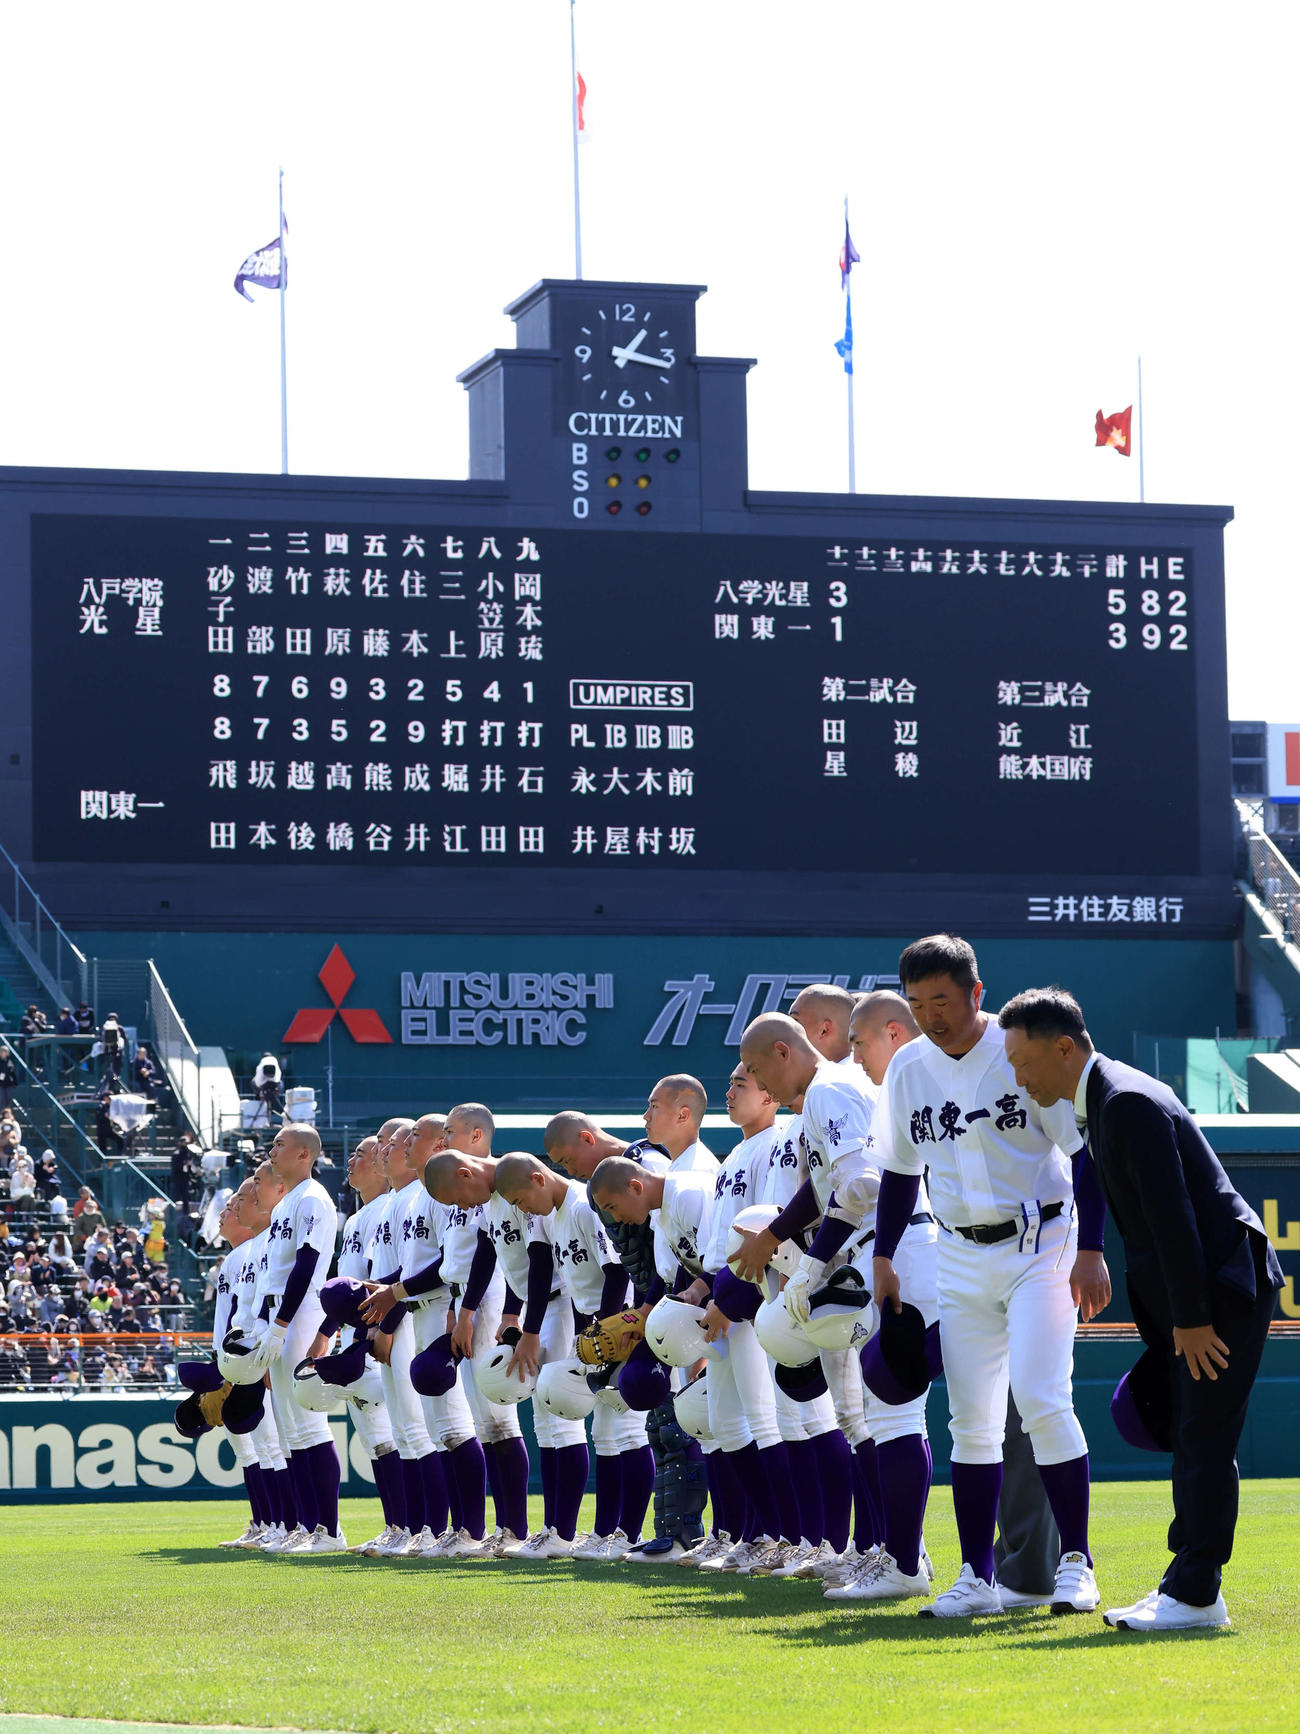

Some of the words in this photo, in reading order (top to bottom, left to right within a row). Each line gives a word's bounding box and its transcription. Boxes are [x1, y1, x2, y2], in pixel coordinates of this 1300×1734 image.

[615, 303, 636, 322] 12
[574, 344, 592, 364] 9
[660, 348, 676, 367] 3
[617, 389, 636, 409] 6
[568, 411, 684, 439] CITIZEN
[571, 442, 588, 466] B
[572, 469, 590, 492] S
[572, 496, 589, 519] O
[247, 532, 272, 552] 二
[286, 531, 311, 554] 三
[324, 532, 349, 555] 四
[363, 533, 388, 557] 五
[402, 534, 425, 558] 六
[439, 535, 464, 559] 七
[477, 536, 502, 560] 八
[515, 536, 541, 562] 九
[1105, 553, 1128, 579] 計
[1139, 556, 1159, 580] H
[1167, 556, 1185, 580] E
[78, 577, 164, 609] 八戸学院
[206, 564, 236, 654] 砂子田
[246, 565, 275, 655] 渡部
[285, 566, 312, 656] 竹田
[323, 567, 352, 656] 萩原
[714, 579, 811, 607] 八学光星
[828, 580, 848, 608] 3
[1107, 588, 1127, 616] 5
[1140, 589, 1161, 617] 8
[1167, 590, 1188, 617] 2
[79, 606, 163, 636] 光星
[361, 568, 390, 657] 佐藤
[400, 569, 429, 658] 住本
[439, 570, 467, 658] 三上
[477, 571, 505, 660] 小笠原
[514, 572, 543, 661] 岡本琉
[714, 613, 812, 641] 関東一
[830, 615, 843, 642] 1
[1108, 622, 1128, 650] 3
[1141, 623, 1162, 651] 9
[1168, 623, 1188, 651] 2
[212, 673, 232, 698] 8
[252, 675, 270, 698] 7
[291, 675, 309, 699] 6
[329, 676, 348, 700] 9
[368, 677, 387, 701] 3
[407, 678, 425, 701] 2
[445, 679, 463, 703] 5
[482, 680, 502, 703] 4
[522, 681, 534, 704] 1
[578, 685, 685, 706] UMPIRES
[821, 676, 918, 704] 第二試合
[997, 680, 1092, 708] 第三試合
[213, 716, 232, 740] 8
[253, 717, 270, 740] 7
[291, 717, 310, 741] 3
[330, 719, 349, 742] 5
[369, 719, 387, 743] 2
[407, 720, 426, 744] 9
[441, 718, 468, 747] 打
[479, 719, 506, 747] 打
[517, 720, 544, 748] 打
[570, 723, 596, 748] PL
[822, 718, 918, 746] 田辺
[998, 721, 1093, 749] 近江
[823, 750, 919, 778] 星稜
[998, 753, 1093, 781] 熊本国府
[80, 789, 165, 820] 関東一
[209, 759, 237, 850] 飛田
[247, 760, 277, 850] 坂本
[287, 760, 316, 851] 越後
[364, 762, 393, 852] 熊谷
[403, 763, 431, 852] 成井
[441, 763, 470, 853] 堀江
[480, 764, 507, 853] 井田
[517, 766, 545, 854] 石田
[570, 766, 598, 855] 永井
[602, 766, 631, 855] 大屋
[635, 767, 663, 855] 木村
[668, 767, 697, 855] 前坂
[1027, 895, 1184, 923] 三井住友銀行
[401, 971, 614, 1009] MITSUBISHI
[401, 1009, 586, 1046] ELECTRIC
[910, 1093, 1027, 1145] 関東一高
